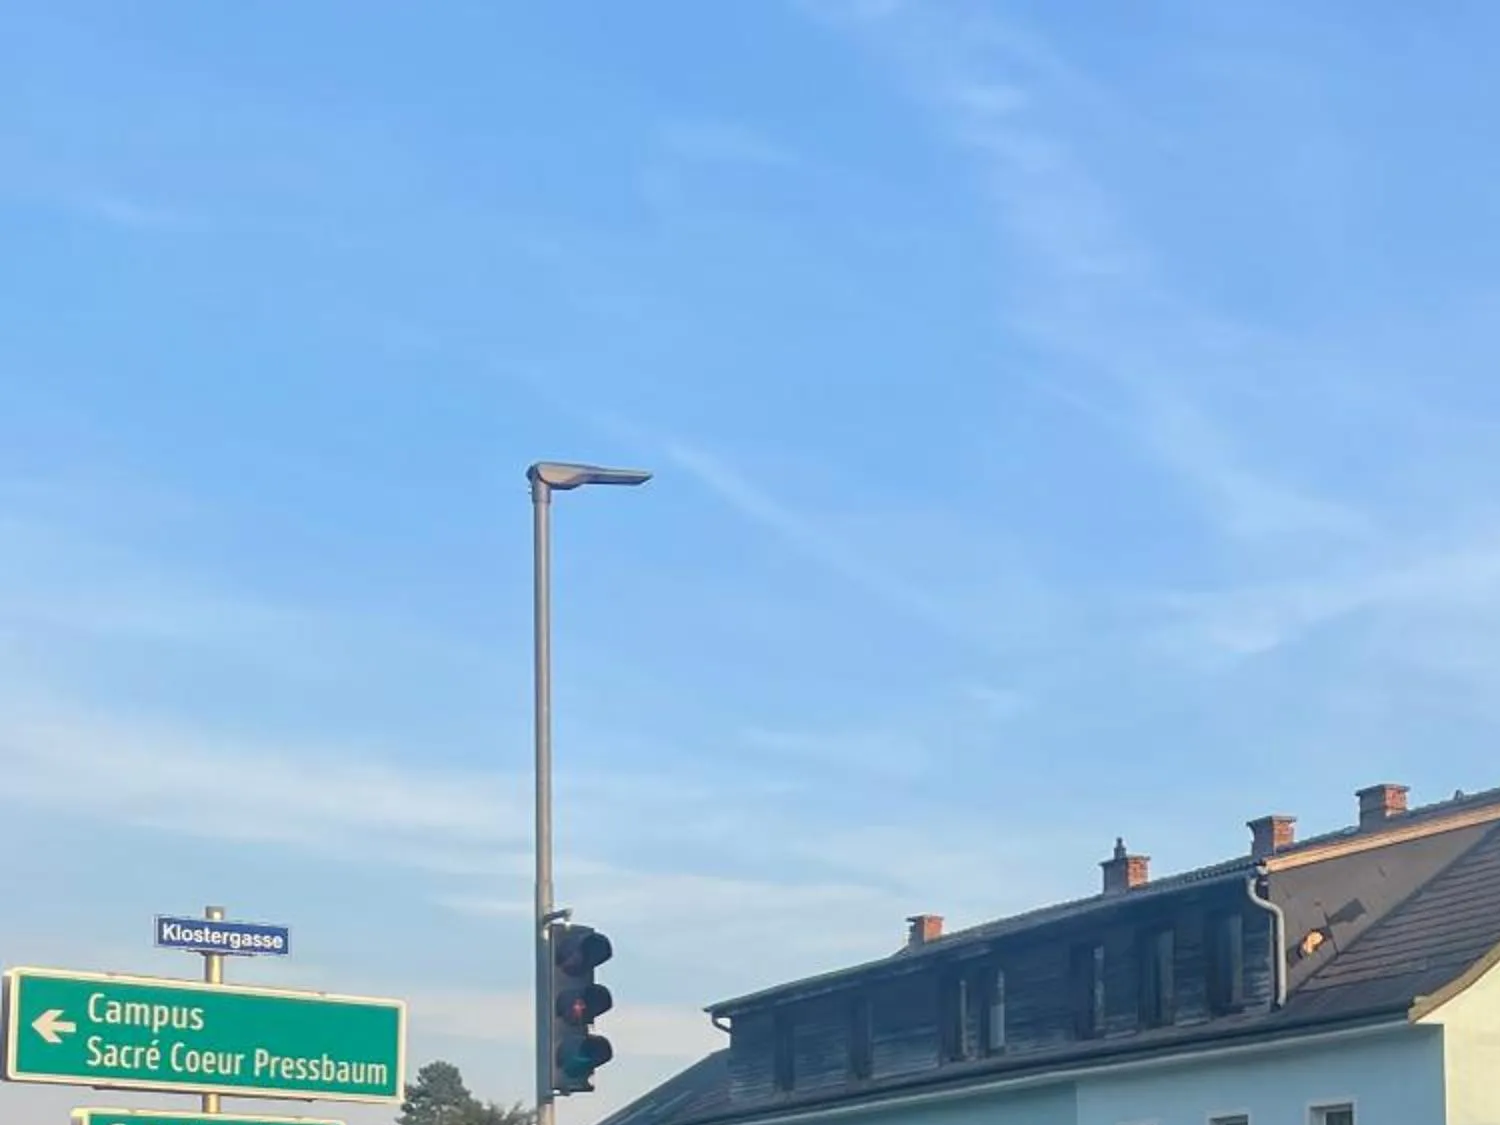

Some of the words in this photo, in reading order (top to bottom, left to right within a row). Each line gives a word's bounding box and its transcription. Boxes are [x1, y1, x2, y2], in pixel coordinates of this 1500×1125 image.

[162, 923, 285, 950] Klostergasse
[88, 993, 205, 1033] Campus
[86, 1036, 161, 1070] Sacré
[171, 1042, 245, 1076] Coeur
[254, 1048, 389, 1086] Pressbaum
